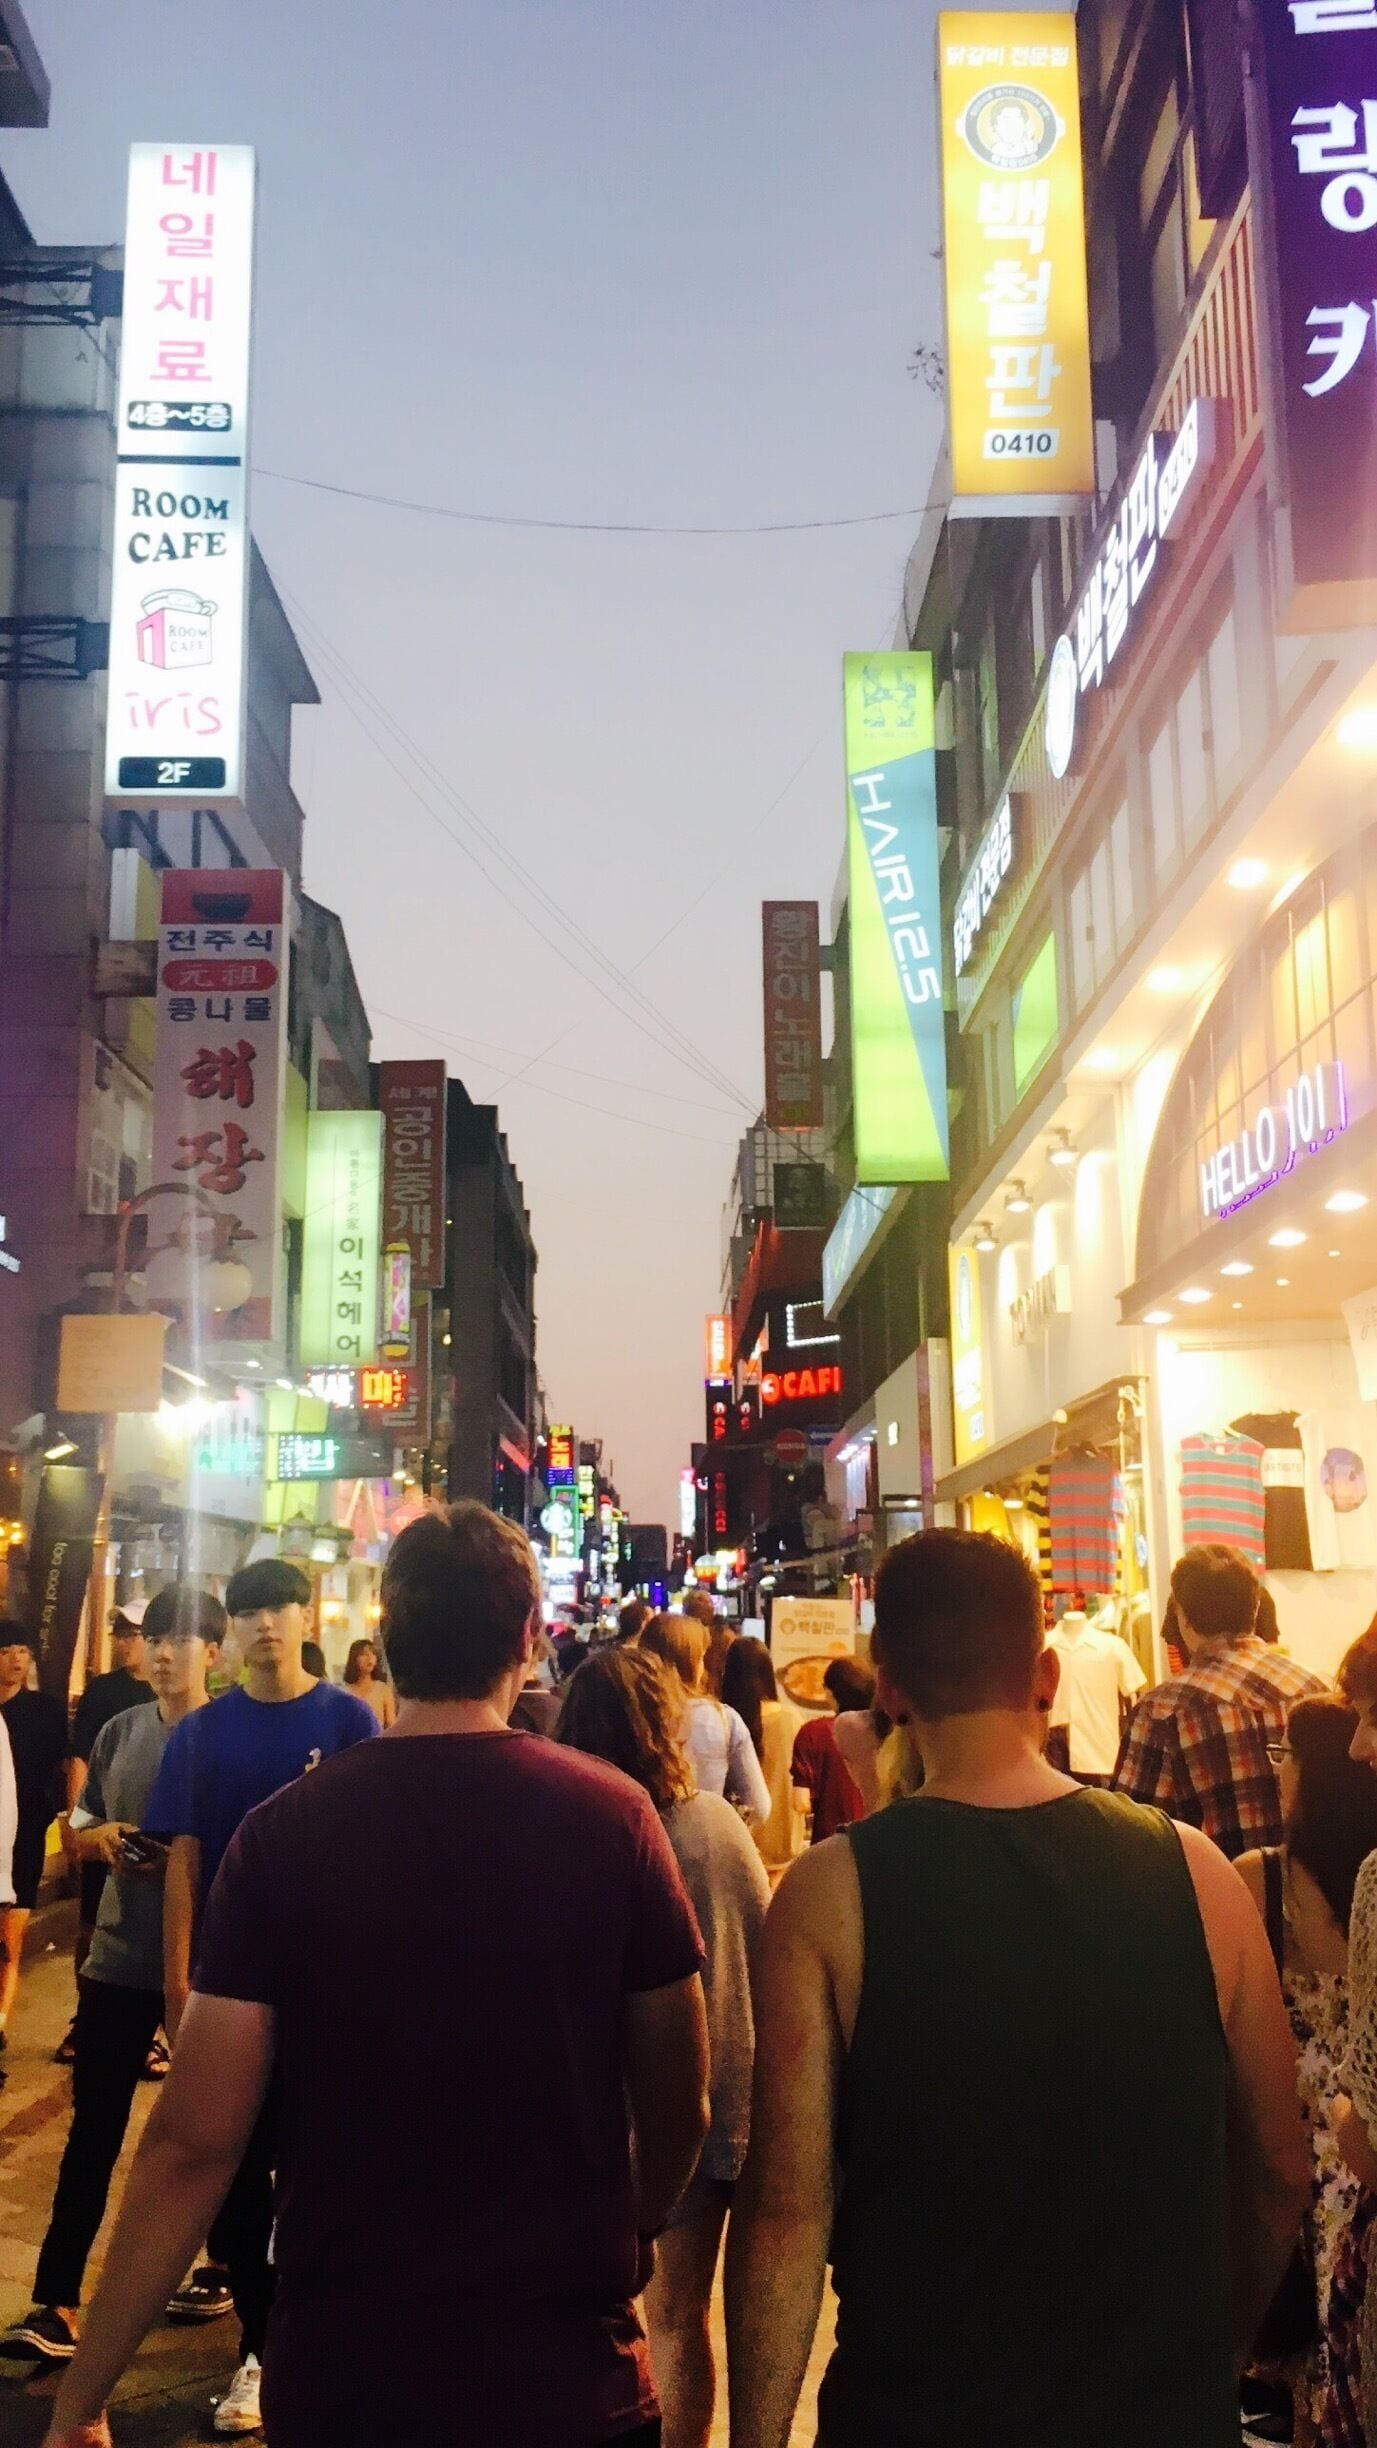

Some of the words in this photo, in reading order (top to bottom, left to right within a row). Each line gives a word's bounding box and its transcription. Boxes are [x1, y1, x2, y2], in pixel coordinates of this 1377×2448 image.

[149, 151, 217, 382] 네일재료
[977, 178, 1062, 418] 백철판
[991, 433, 1052, 453] 0410
[131, 488, 229, 520] ROOM
[127, 531, 227, 564] CAFE
[168, 624, 208, 638] ROOM
[170, 640, 205, 652] CAFE
[124, 692, 222, 735] iris
[156, 762, 192, 784] 2F
[853, 773, 915, 906] HAIR
[166, 929, 274, 952] 전주식
[166, 997, 272, 1022] 콩나물
[1200, 1106, 1276, 1217] HELLO
[336, 1237, 363, 1357] 이석헤어
[46, 1568, 62, 1601] cool
